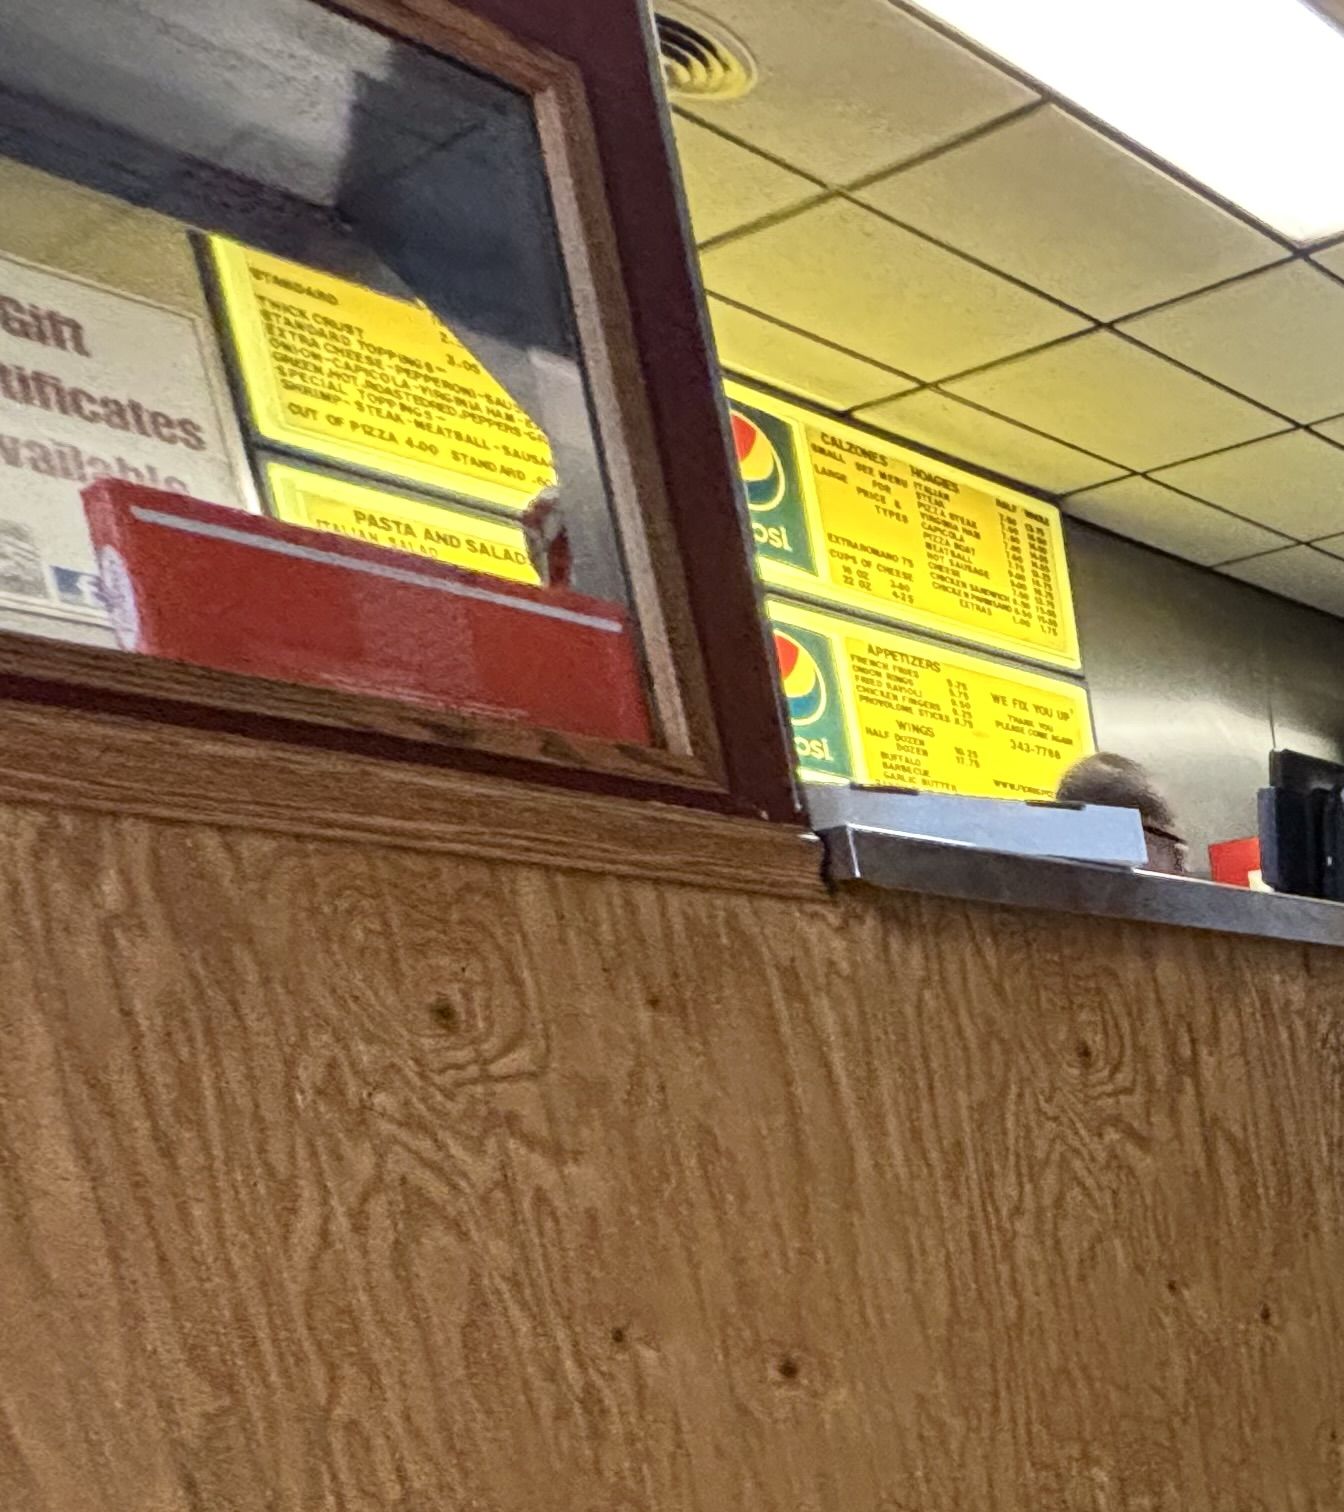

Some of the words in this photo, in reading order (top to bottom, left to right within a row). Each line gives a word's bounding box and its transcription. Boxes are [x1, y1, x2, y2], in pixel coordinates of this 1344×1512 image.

[820, 432, 888, 467] CALZONES
[353, 509, 417, 538] PASTA
[424, 527, 461, 548] AND
[867, 643, 941, 673] APPETIZERS
[990, 692, 1008, 706] WE
[1012, 698, 1029, 712] FIX
[1033, 704, 1053, 718] YOU
[894, 733, 925, 746] DOZEN
[896, 719, 935, 738] WINGS
[896, 743, 929, 757] DOZEN
